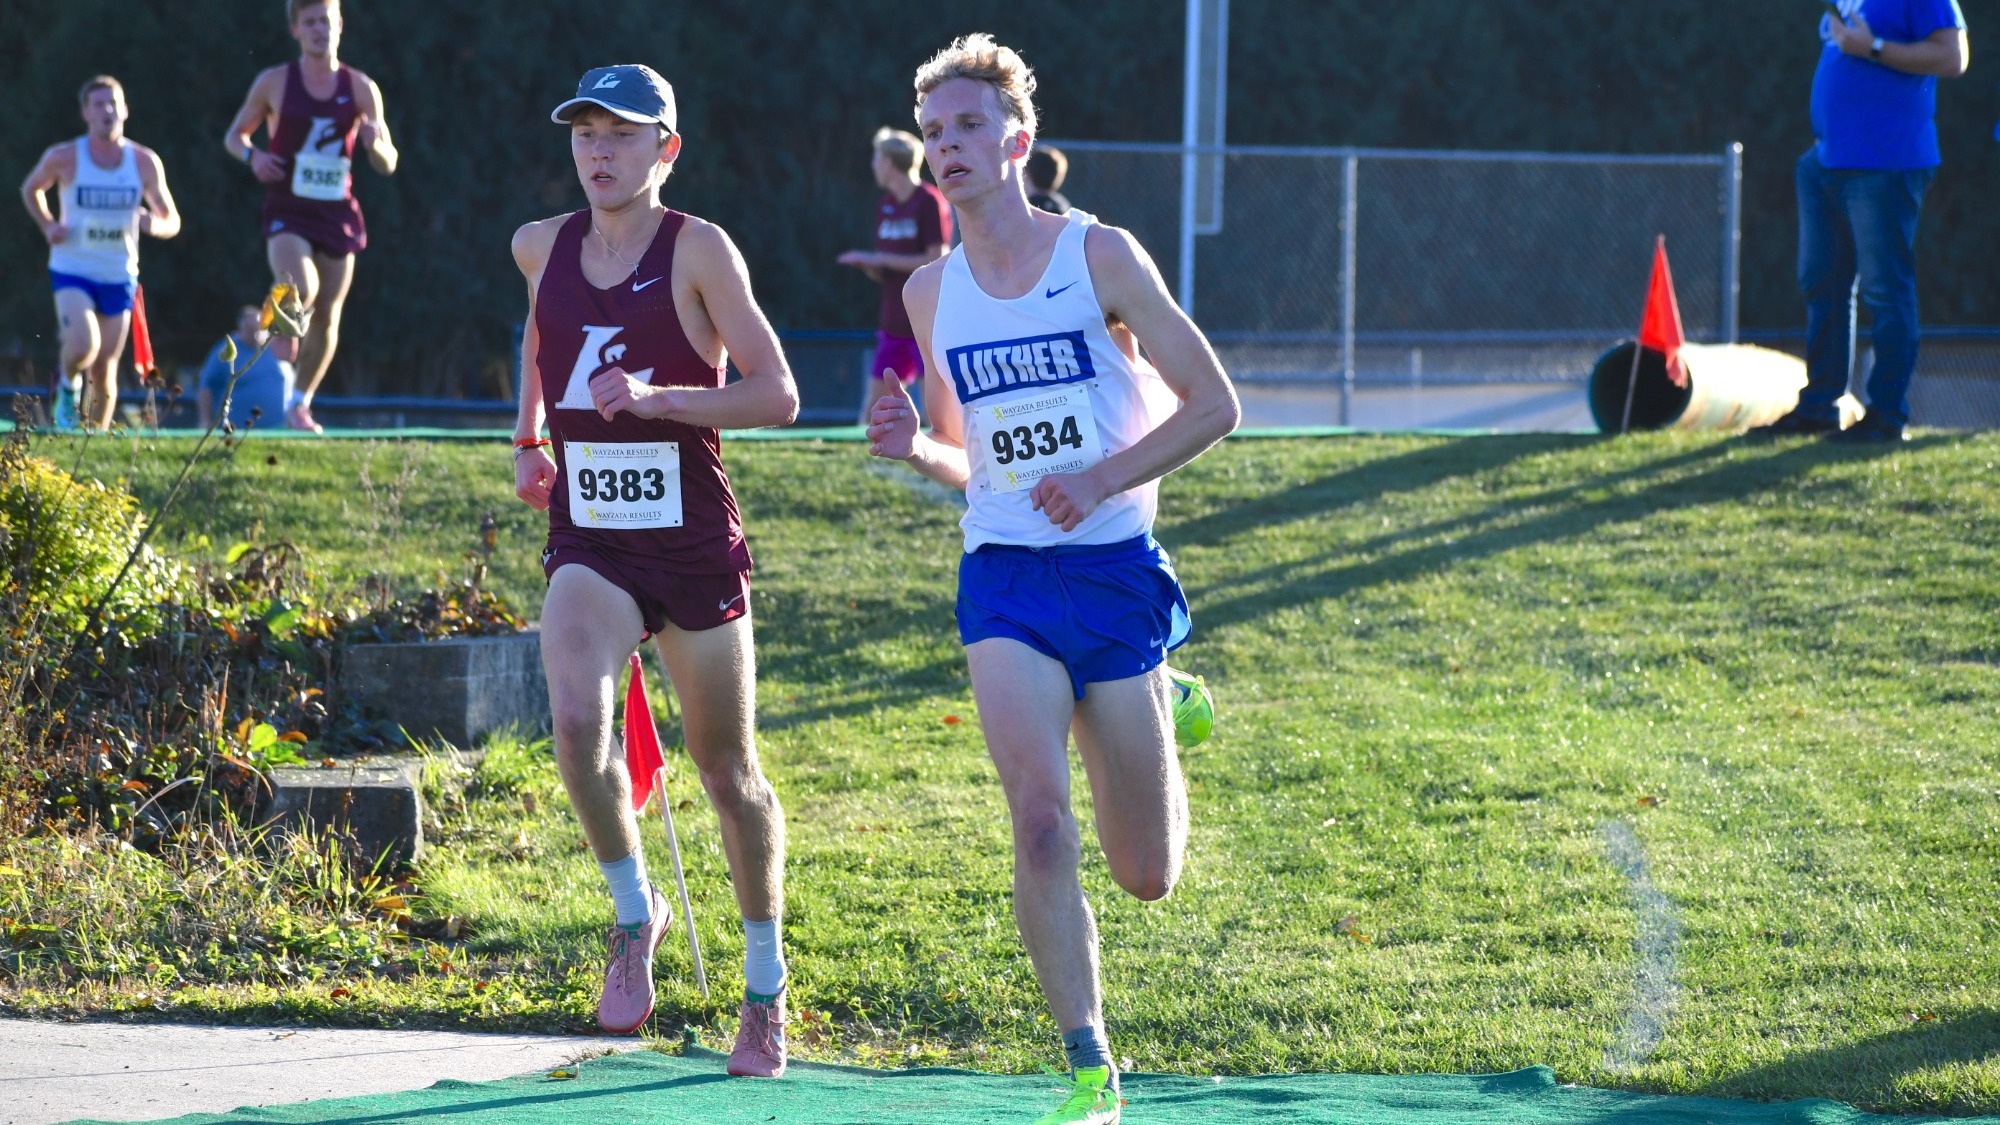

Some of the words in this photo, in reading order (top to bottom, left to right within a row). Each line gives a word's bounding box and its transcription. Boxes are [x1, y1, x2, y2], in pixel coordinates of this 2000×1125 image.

[957, 338, 1082, 395] LUTHER
[1001, 403, 1034, 415] WAYZATA
[1036, 395, 1068, 408] RESULTS
[991, 415, 1084, 465] 9334
[592, 448, 625, 456] WAYZATA
[626, 448, 659, 456] RESULTS
[1015, 468, 1049, 480] WAYZATA
[1050, 460, 1084, 472] RESULTS
[578, 467, 665, 502] 9383
[595, 512, 627, 520] WAYZATA
[629, 511, 662, 519] RESULTS
